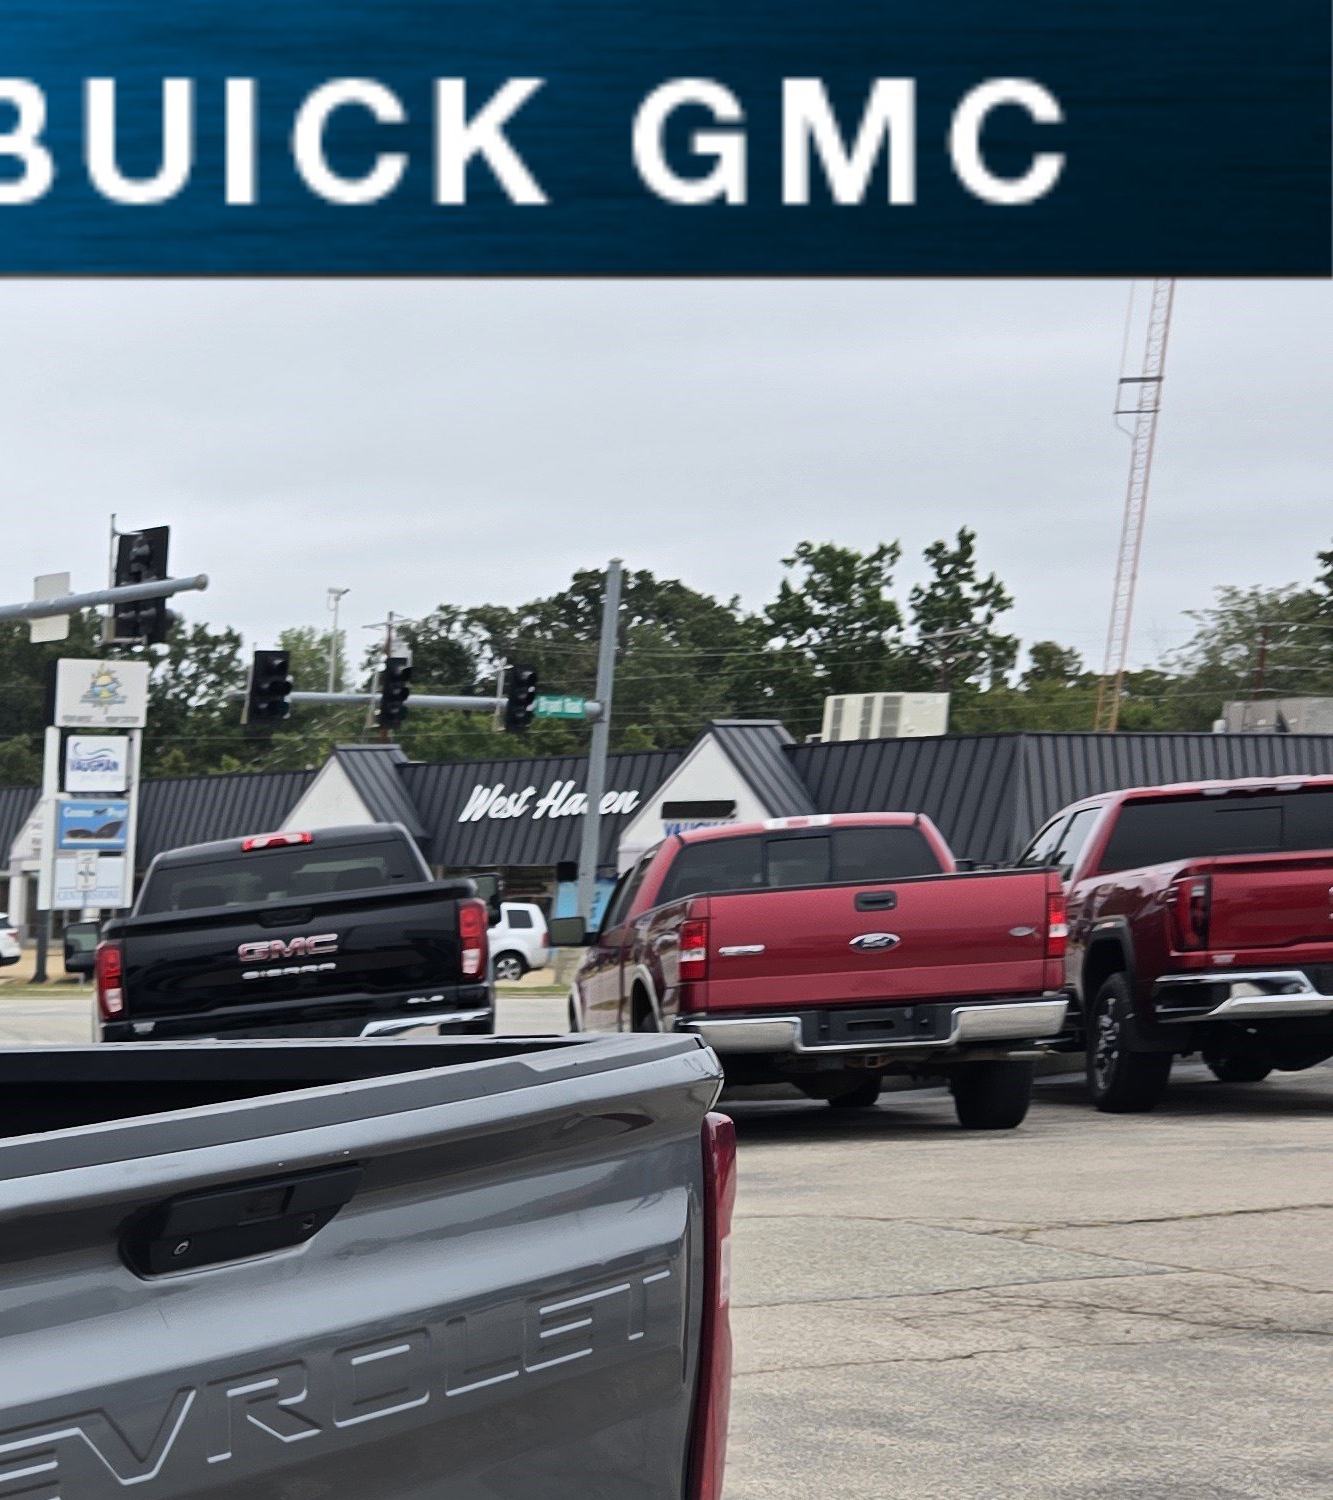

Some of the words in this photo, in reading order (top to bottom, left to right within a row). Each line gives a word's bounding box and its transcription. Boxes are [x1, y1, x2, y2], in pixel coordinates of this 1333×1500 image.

[458, 783, 536, 822] West
[532, 780, 641, 820] Haen
[237, 933, 338, 962] GMC
